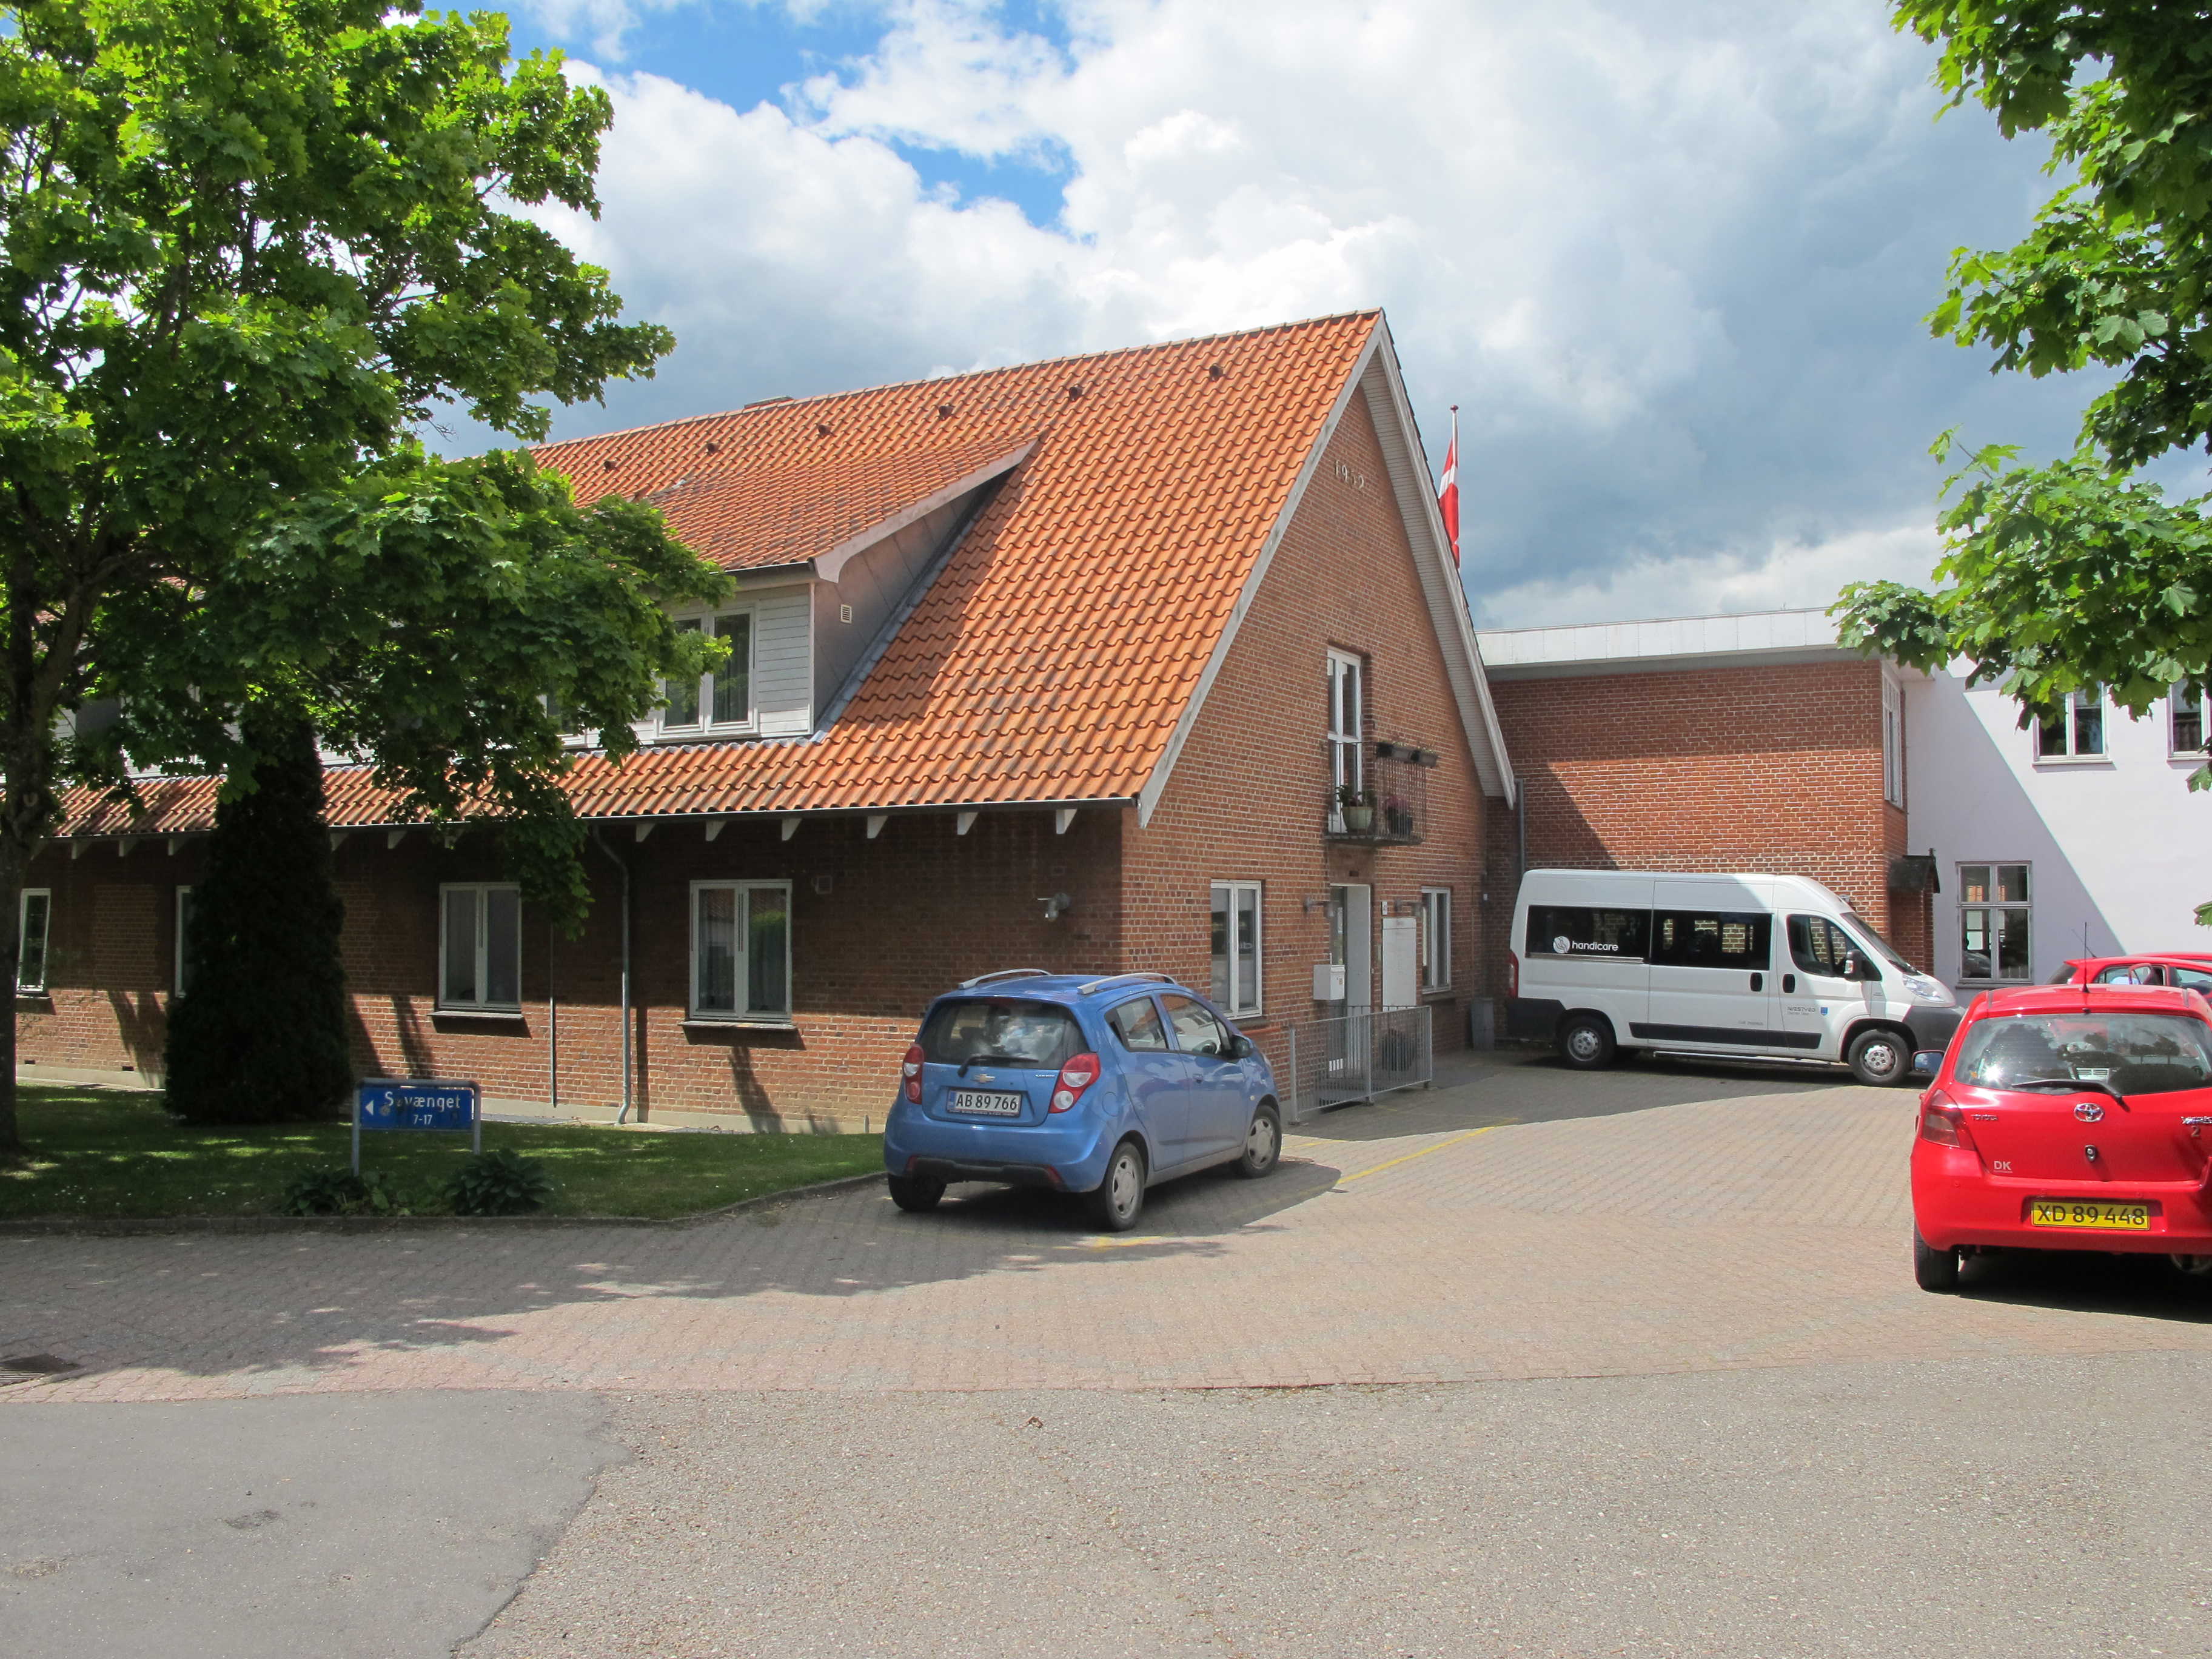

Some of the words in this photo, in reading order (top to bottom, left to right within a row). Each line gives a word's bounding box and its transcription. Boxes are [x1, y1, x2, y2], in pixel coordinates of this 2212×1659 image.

[1572, 940, 1618, 951] handicare
[956, 1094, 973, 1107] AB
[975, 1095, 991, 1108] 89
[994, 1096, 1017, 1110] 766
[413, 1114, 432, 1125] 7-17
[1994, 1161, 2011, 1170] DK
[2037, 1205, 2066, 1222] XD
[2073, 1206, 2099, 1223] 89
[2104, 1207, 2145, 1225] 448
